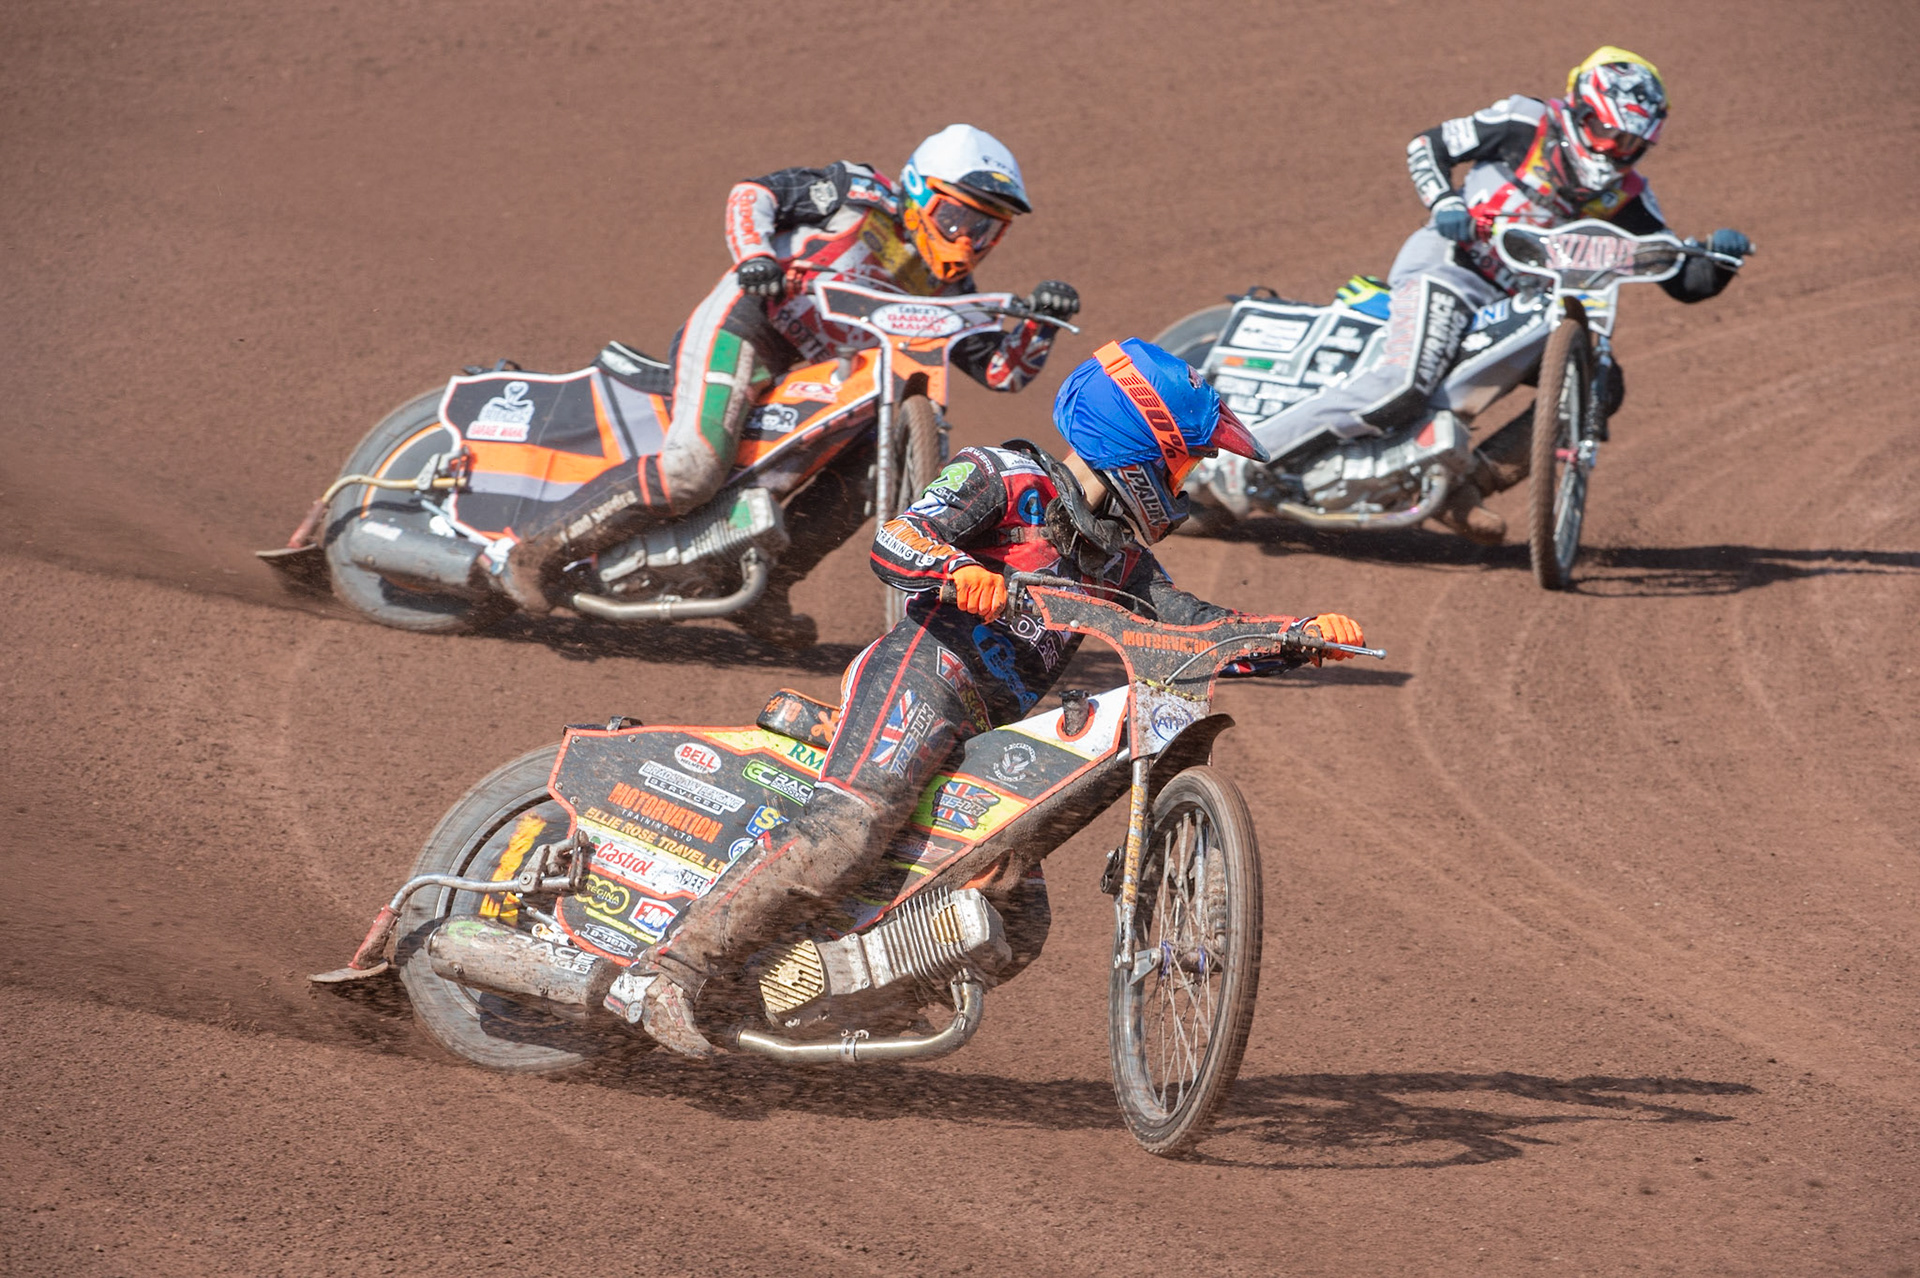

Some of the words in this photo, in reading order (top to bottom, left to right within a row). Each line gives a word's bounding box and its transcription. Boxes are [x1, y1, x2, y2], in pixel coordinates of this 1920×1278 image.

[1117, 373, 1187, 459] 100%
[1122, 630, 1217, 656] MOTORVATION
[680, 745, 717, 770] BELL
[889, 702, 936, 779] TRS-UK
[650, 777, 721, 810] SERVICES
[607, 781, 724, 844] MOTORVATION
[621, 809, 669, 832] TRAINING
[673, 829, 693, 842] LTD
[584, 806, 625, 829] ELLIE
[620, 821, 659, 845] ROSE
[656, 835, 709, 867] TRAVEL
[596, 841, 655, 877] Castrol
[585, 882, 620, 904] REGINA
